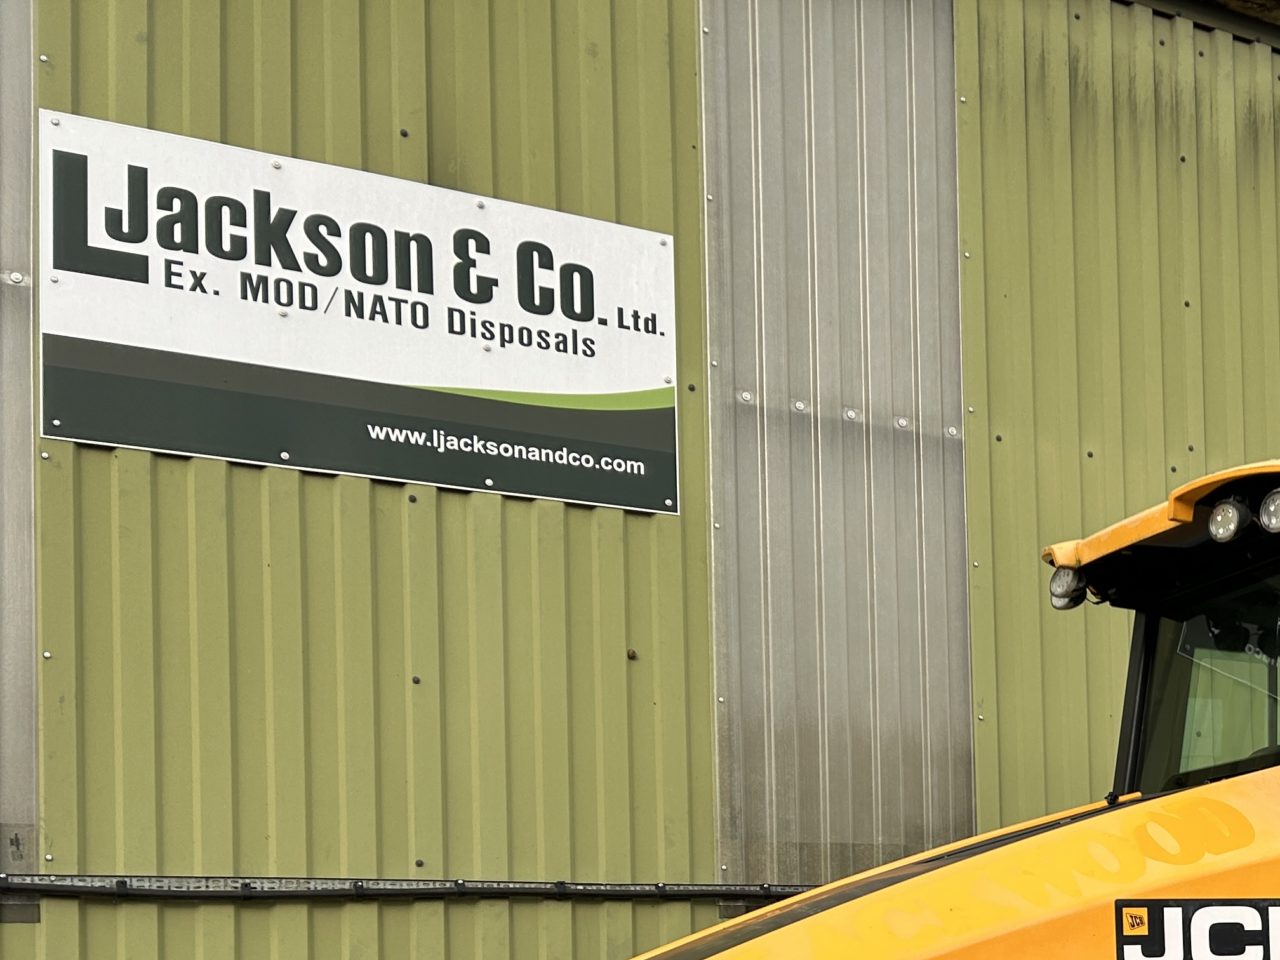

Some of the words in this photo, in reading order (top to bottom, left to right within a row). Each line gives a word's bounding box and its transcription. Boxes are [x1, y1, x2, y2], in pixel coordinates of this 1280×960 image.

[164, 260, 220, 297] Ex.
[447, 307, 597, 359] Disposals
[453, 228, 499, 304] &
[516, 240, 608, 327] Co.
[616, 306, 667, 338] Ltd.
[366, 421, 646, 476] www.ljacksonandco.com
